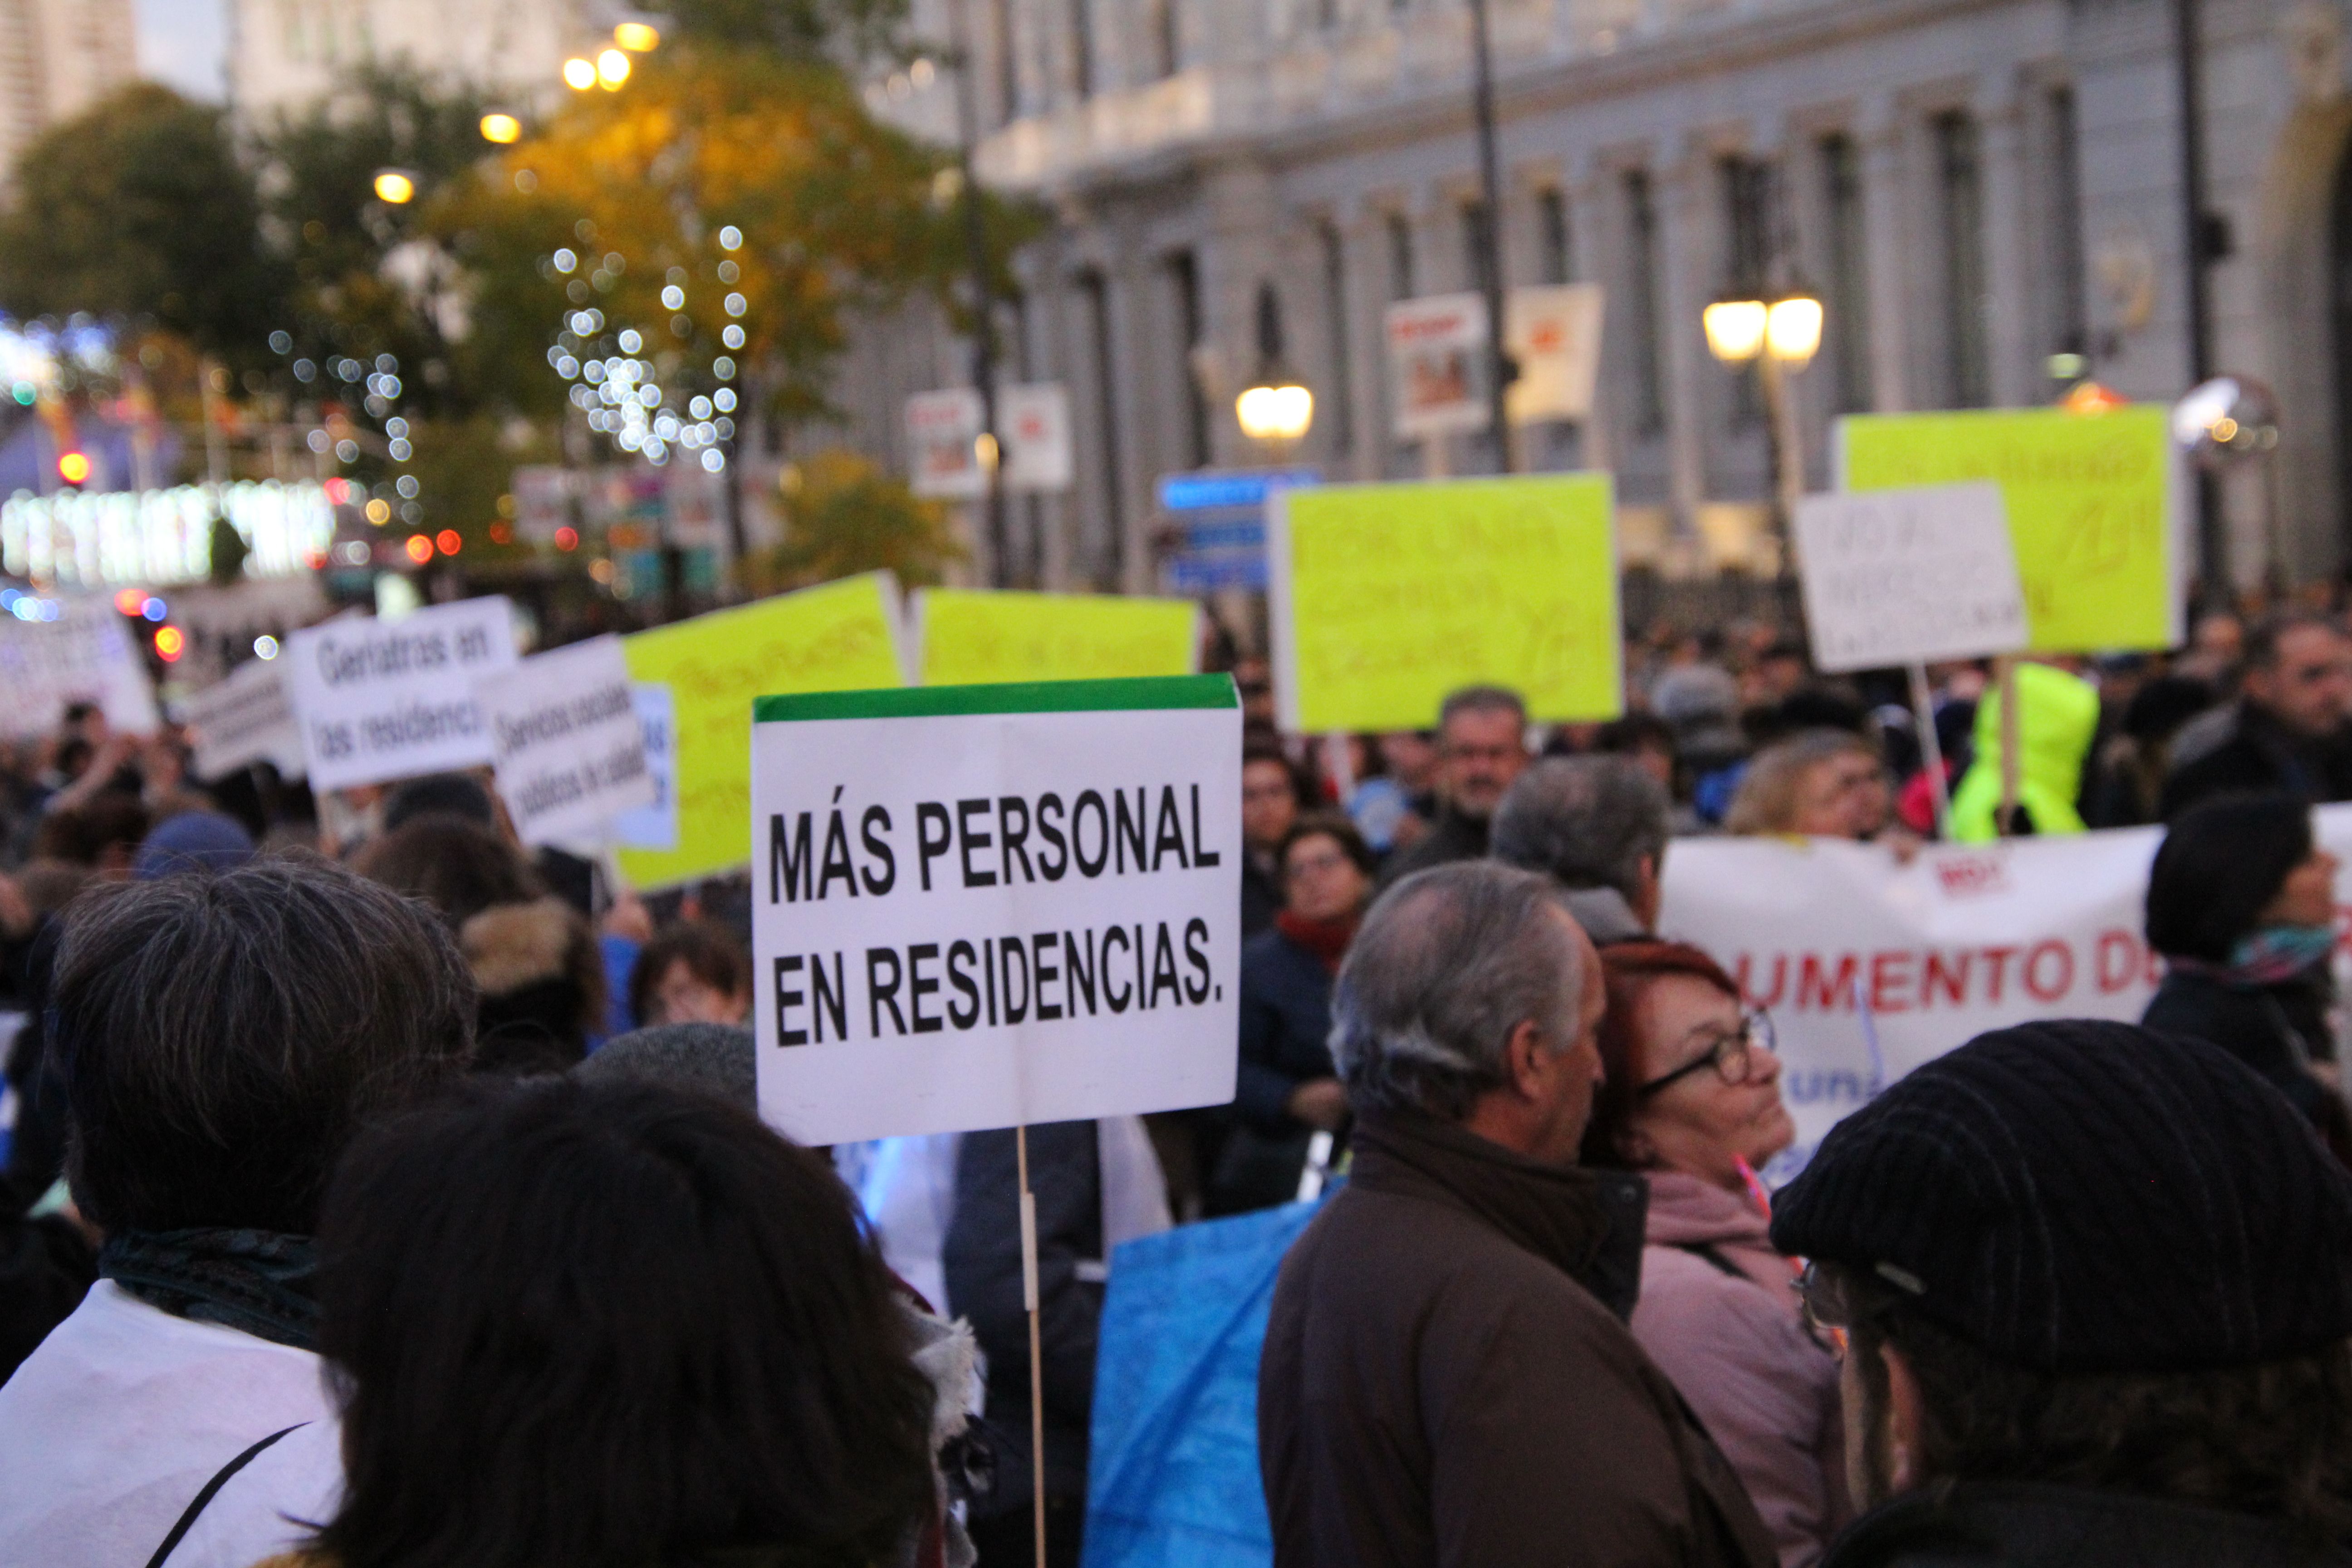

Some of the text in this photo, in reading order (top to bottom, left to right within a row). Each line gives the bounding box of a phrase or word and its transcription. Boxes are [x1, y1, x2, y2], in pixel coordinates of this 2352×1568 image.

[317, 624, 490, 688] Geriatras en
[360, 696, 484, 751] residenci
[769, 783, 1221, 904] MÁS PERSONAL
[774, 917, 1222, 1048] EN RESIDENCIAS.
[1735, 938, 2075, 1014] UMENTO
